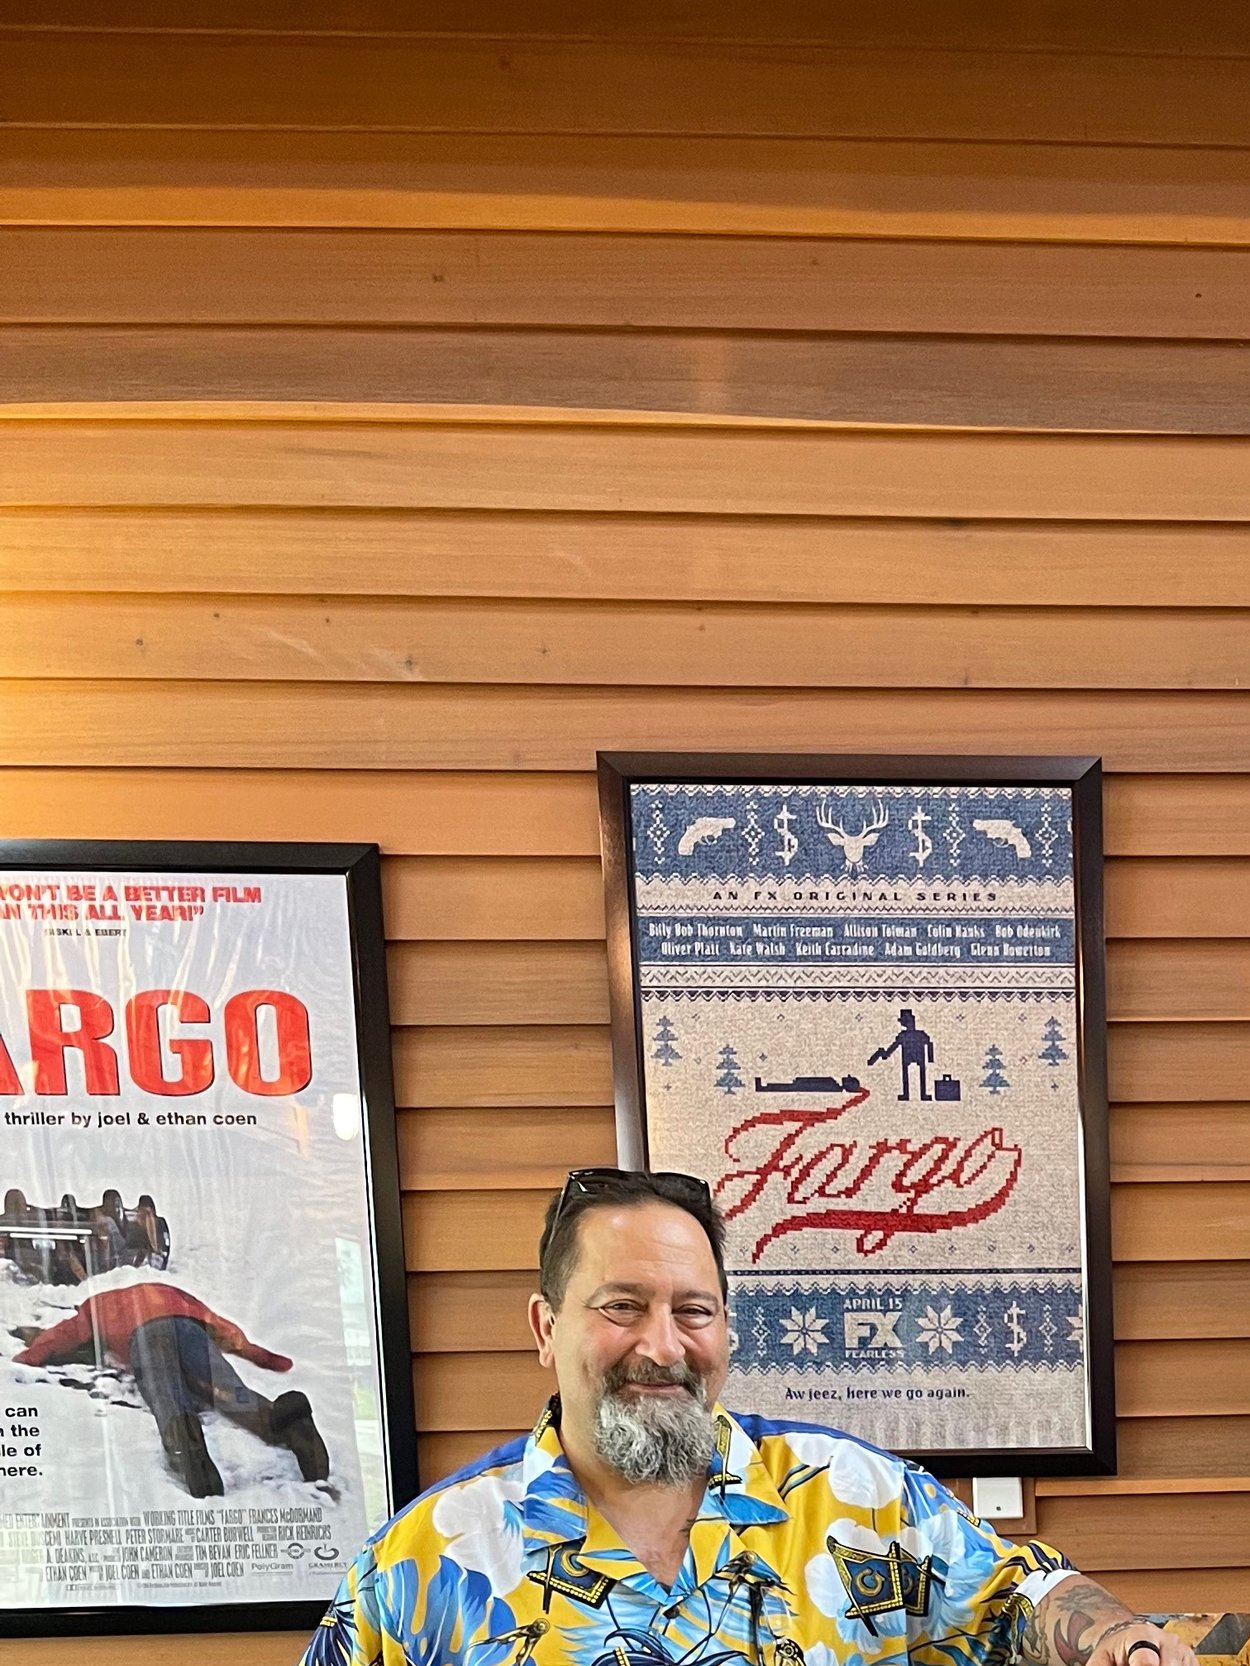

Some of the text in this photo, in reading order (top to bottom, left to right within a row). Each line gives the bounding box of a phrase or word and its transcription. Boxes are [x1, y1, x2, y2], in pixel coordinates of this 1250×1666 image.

[66, 885, 96, 901] BE
[103, 885, 118, 901] A
[124, 886, 205, 902] BETTER
[212, 887, 262, 903] FILM
[713, 891, 997, 901] AN FX ORIGINAL SERIES
[85, 905, 122, 921] ALL
[95, 928, 127, 937] EBERT
[649, 923, 1061, 939] Billy Bob Thornton Martin Freeman Allison Tolman Colin Hanks Bob Odenkirk
[661, 942, 1051, 959] Oliver Platt Kate Walsh Keith Carradine Adam Goldberg Glenn Howerton
[5, 1112, 257, 1128] thriller by joel & ethan coen
[714, 1088, 1022, 1264] Fargo
[843, 1298, 903, 1311] APRIL 15
[844, 1311, 903, 1348] FX
[845, 1349, 905, 1359] FEARLESS
[785, 1387, 970, 1402] Aw jeez, here we go again.
[5, 1407, 38, 1418] can
[11, 1424, 40, 1437] the
[0, 1443, 41, 1457] le of
[143, 1510, 175, 1526] WORKING
[177, 1510, 194, 1525] TITLE
[196, 1509, 215, 1525] FILMS
[249, 1508, 278, 1524] FRANCES
[126, 1529, 146, 1544] PETER
[148, 1528, 184, 1543] STORMARE
[196, 1527, 222, 1542] CARTER
[223, 1527, 254, 1542] BURWELL
[279, 1525, 294, 1541] RICK
[296, 1525, 332, 1540] HEINRICHS
[122, 1547, 138, 1562] JOHN
[141, 1546, 172, 1562] CAMERON
[195, 1545, 208, 1560] TIM
[209, 1545, 231, 1560] BEVAN
[234, 1544, 250, 1559] ERIC
[252, 1543, 278, 1559] FELLNER
[45, 1566, 67, 1581] ETHAN
[69, 1565, 87, 1581] COEN
[105, 1565, 120, 1581] JOEL
[121, 1564, 139, 1580] COEN
[151, 1563, 173, 1579] ETHAN
[175, 1563, 193, 1578] COEN
[210, 1562, 225, 1579] JOEL
[227, 1562, 244, 1577] COEN
[251, 1562, 294, 1572] PolyGram
